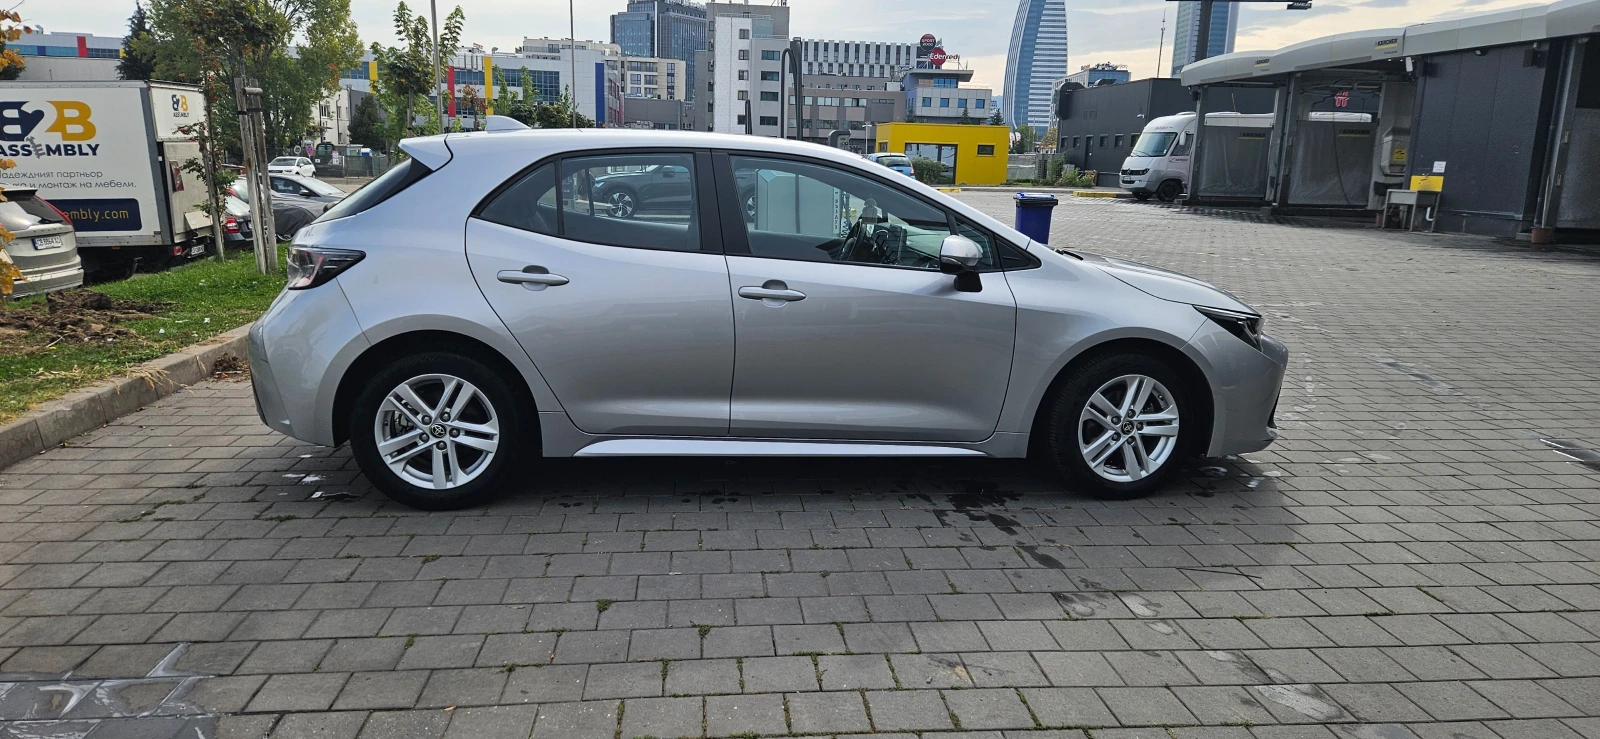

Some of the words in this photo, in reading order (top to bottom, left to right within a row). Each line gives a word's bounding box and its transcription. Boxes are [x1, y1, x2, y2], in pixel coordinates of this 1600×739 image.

[0, 101, 97, 141] B2B
[56, 171, 103, 179] партньор
[95, 180, 137, 188] мебели.
